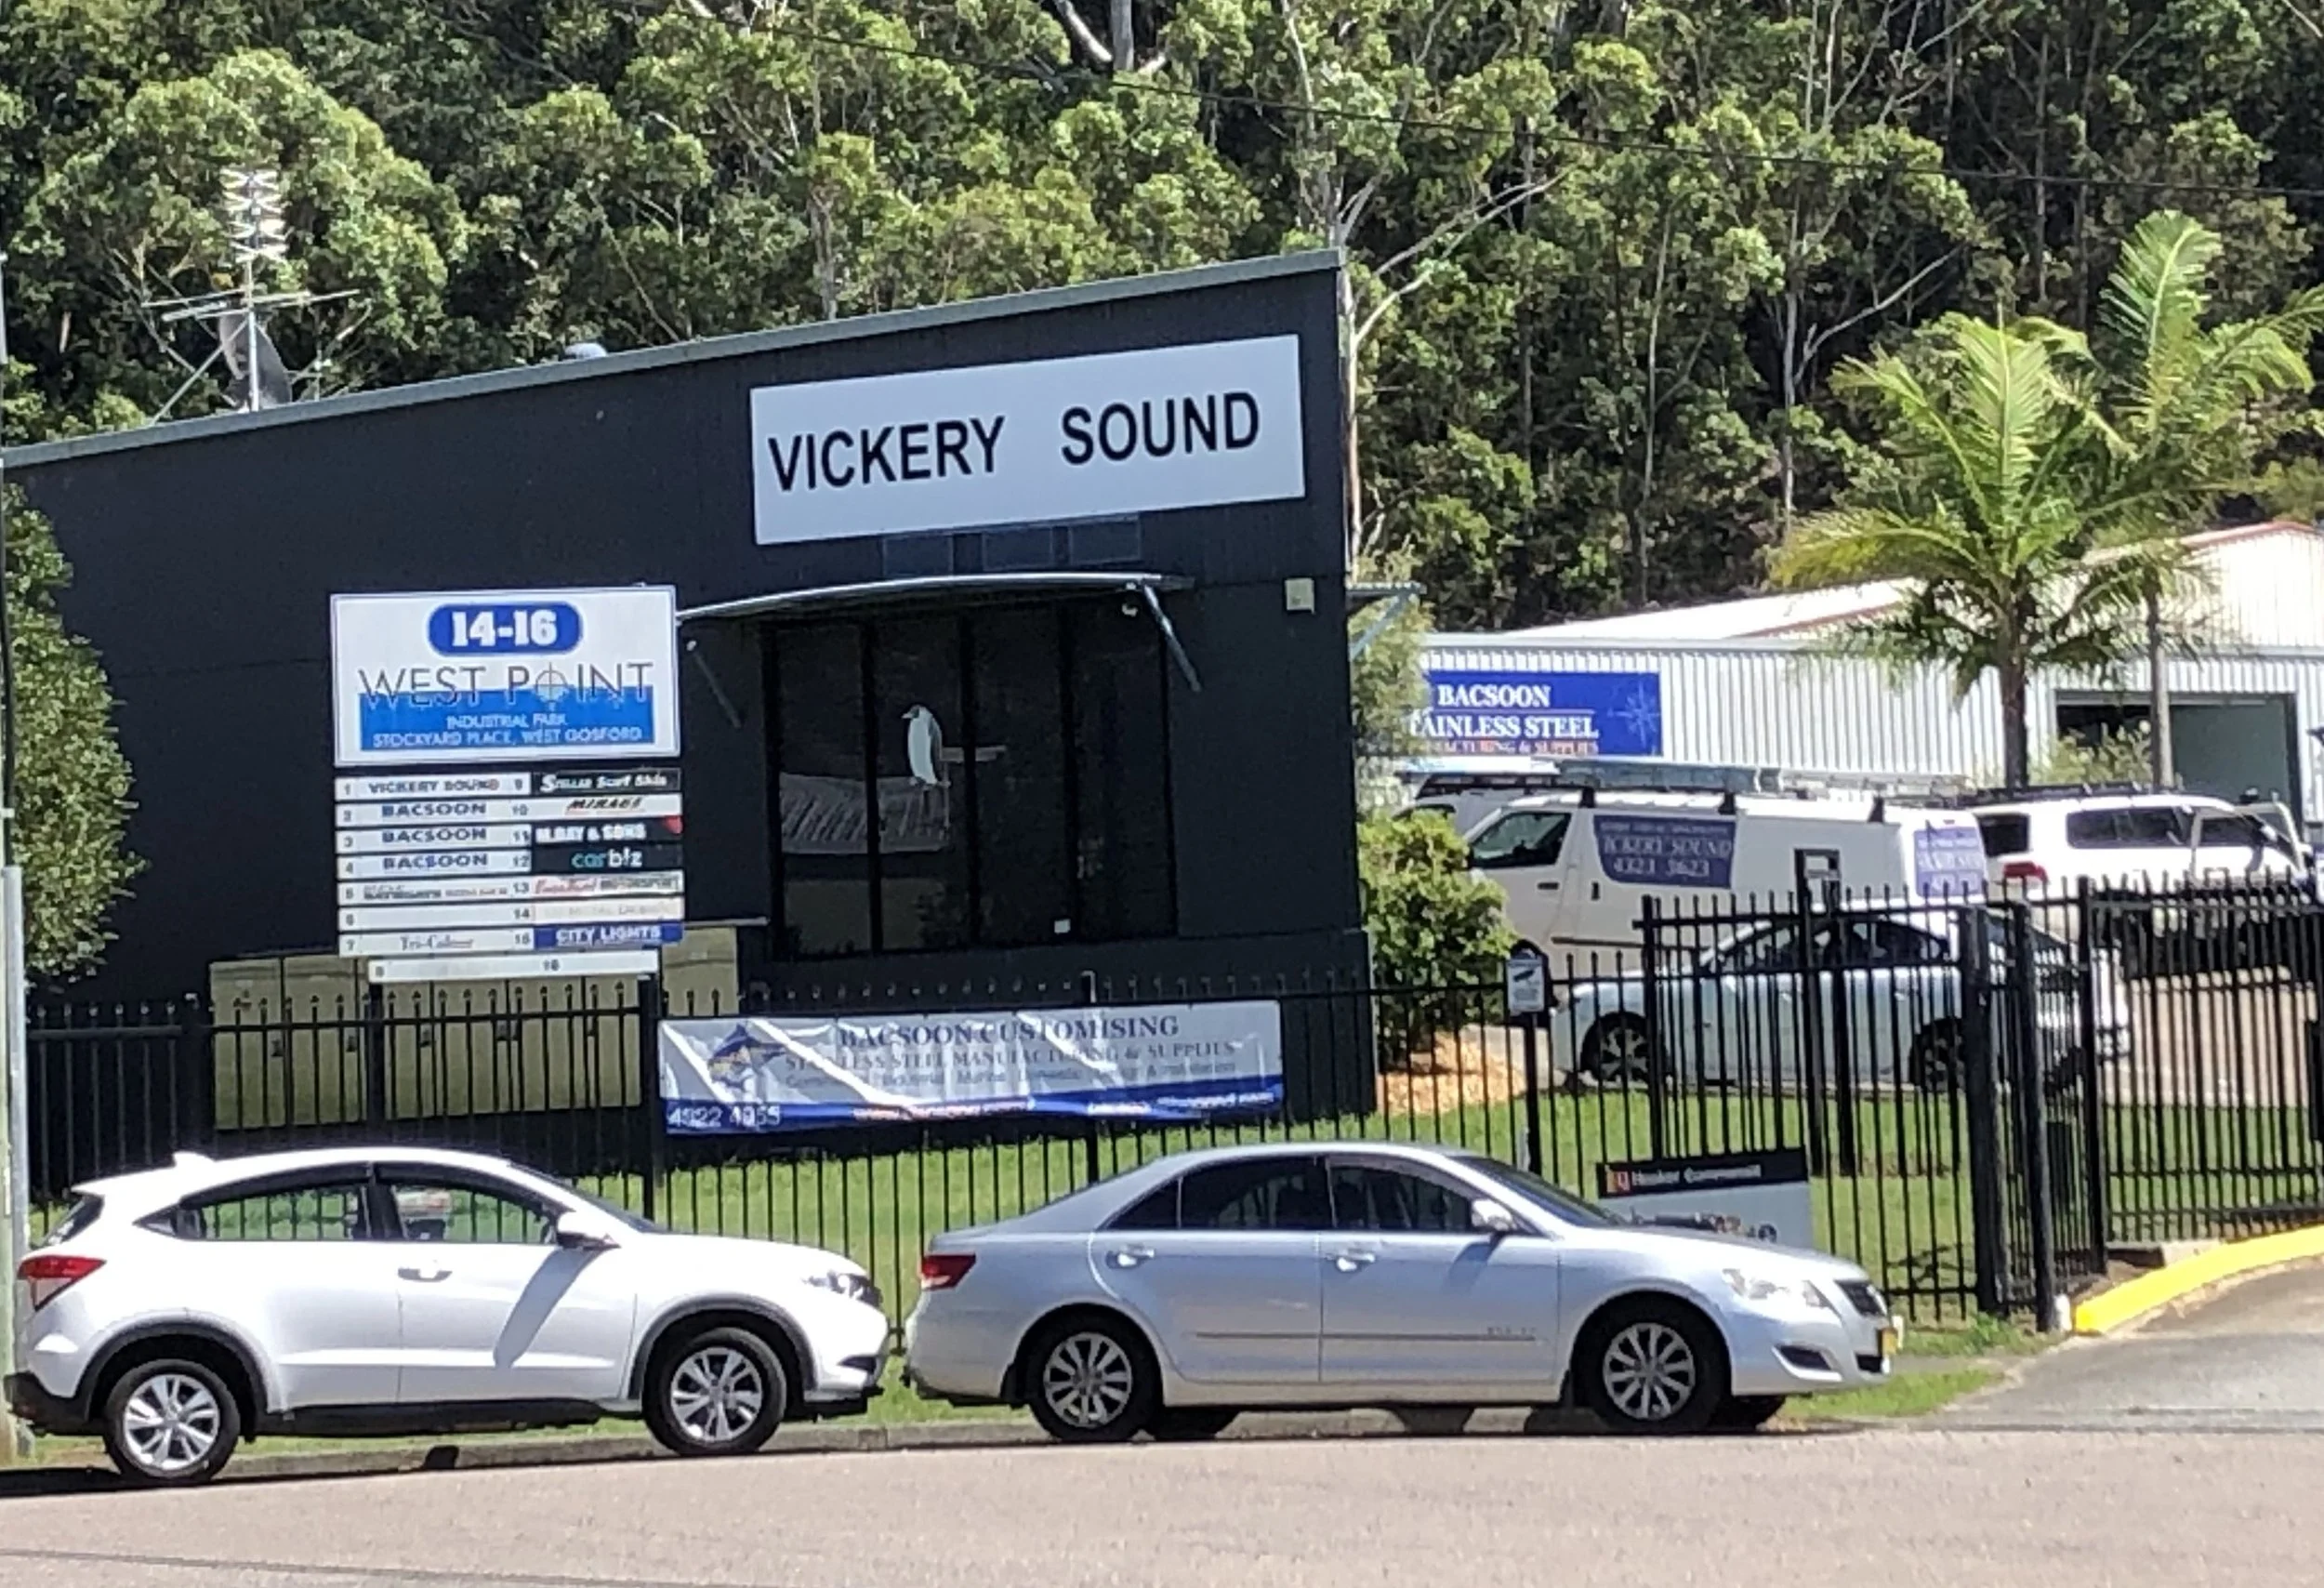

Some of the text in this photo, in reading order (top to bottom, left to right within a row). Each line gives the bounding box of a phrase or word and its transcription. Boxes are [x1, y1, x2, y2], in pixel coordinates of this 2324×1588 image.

[768, 391, 1260, 491] VICKERY SOUND
[452, 609, 558, 647] 14-16
[358, 662, 654, 706] WEST POINT
[1437, 683, 1552, 708] BACSOON
[447, 715, 530, 730] INDUSTRIAL
[1408, 711, 1599, 739] TAINLESS STEEL
[373, 730, 461, 748] STOCKYARD
[522, 728, 561, 745] WEST
[565, 725, 642, 743] GOSFORD
[382, 802, 486, 817] BACSOON
[382, 827, 487, 843] BACSOON
[383, 854, 488, 869] BACSOON
[556, 926, 595, 945] CITY
[601, 924, 661, 940] LIGHTS
[838, 1015, 1179, 1047] BACSOON CUSTOMISING
[954, 1045, 1118, 1069] MANUFACTING
